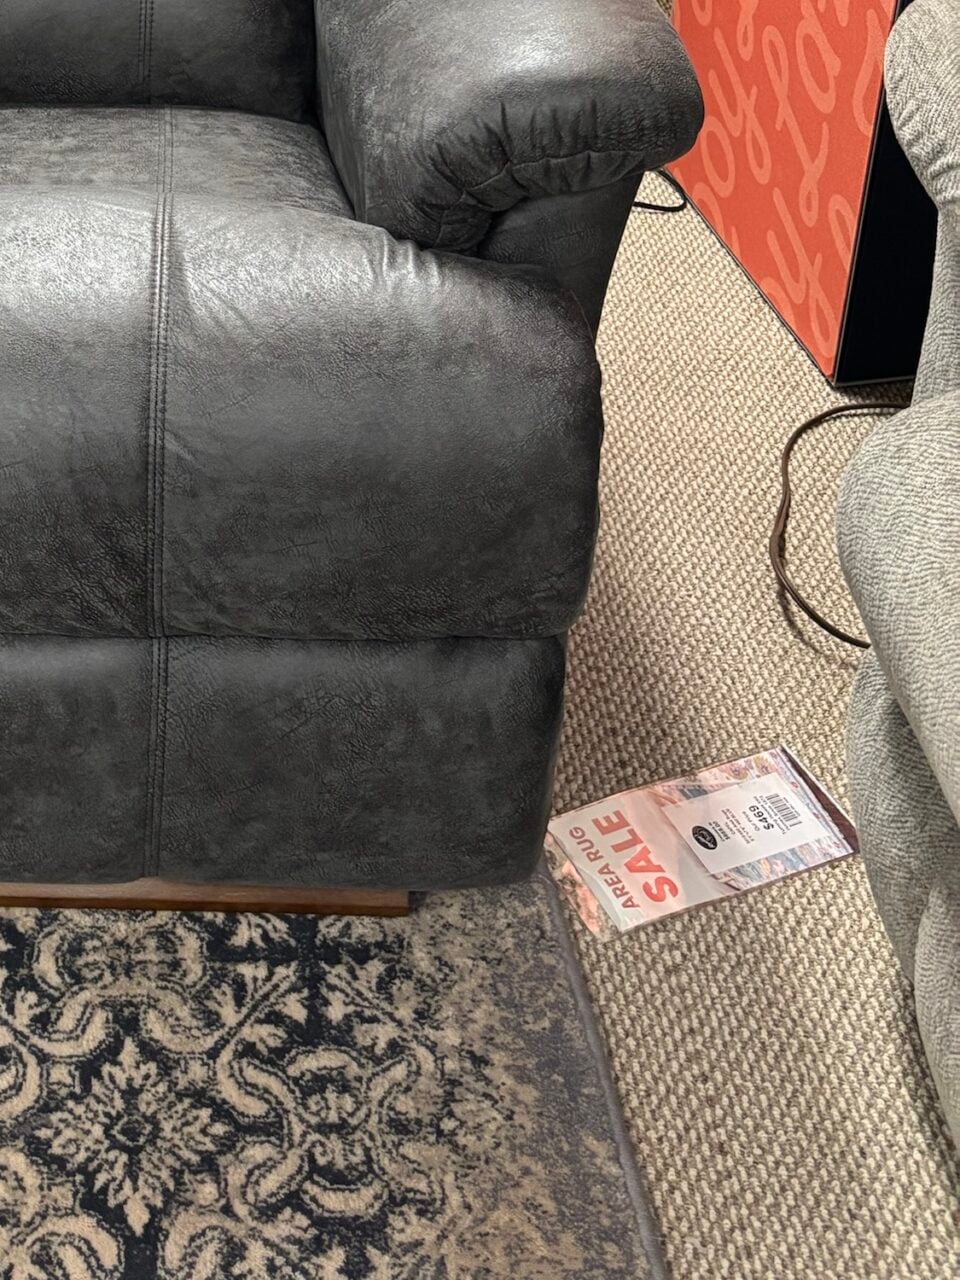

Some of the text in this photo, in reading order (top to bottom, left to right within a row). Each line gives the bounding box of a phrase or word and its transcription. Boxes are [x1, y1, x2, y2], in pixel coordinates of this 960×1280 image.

[591, 809, 679, 903] SALE
[748, 805, 775, 830] $469
[568, 826, 641, 909] AREA RUG
